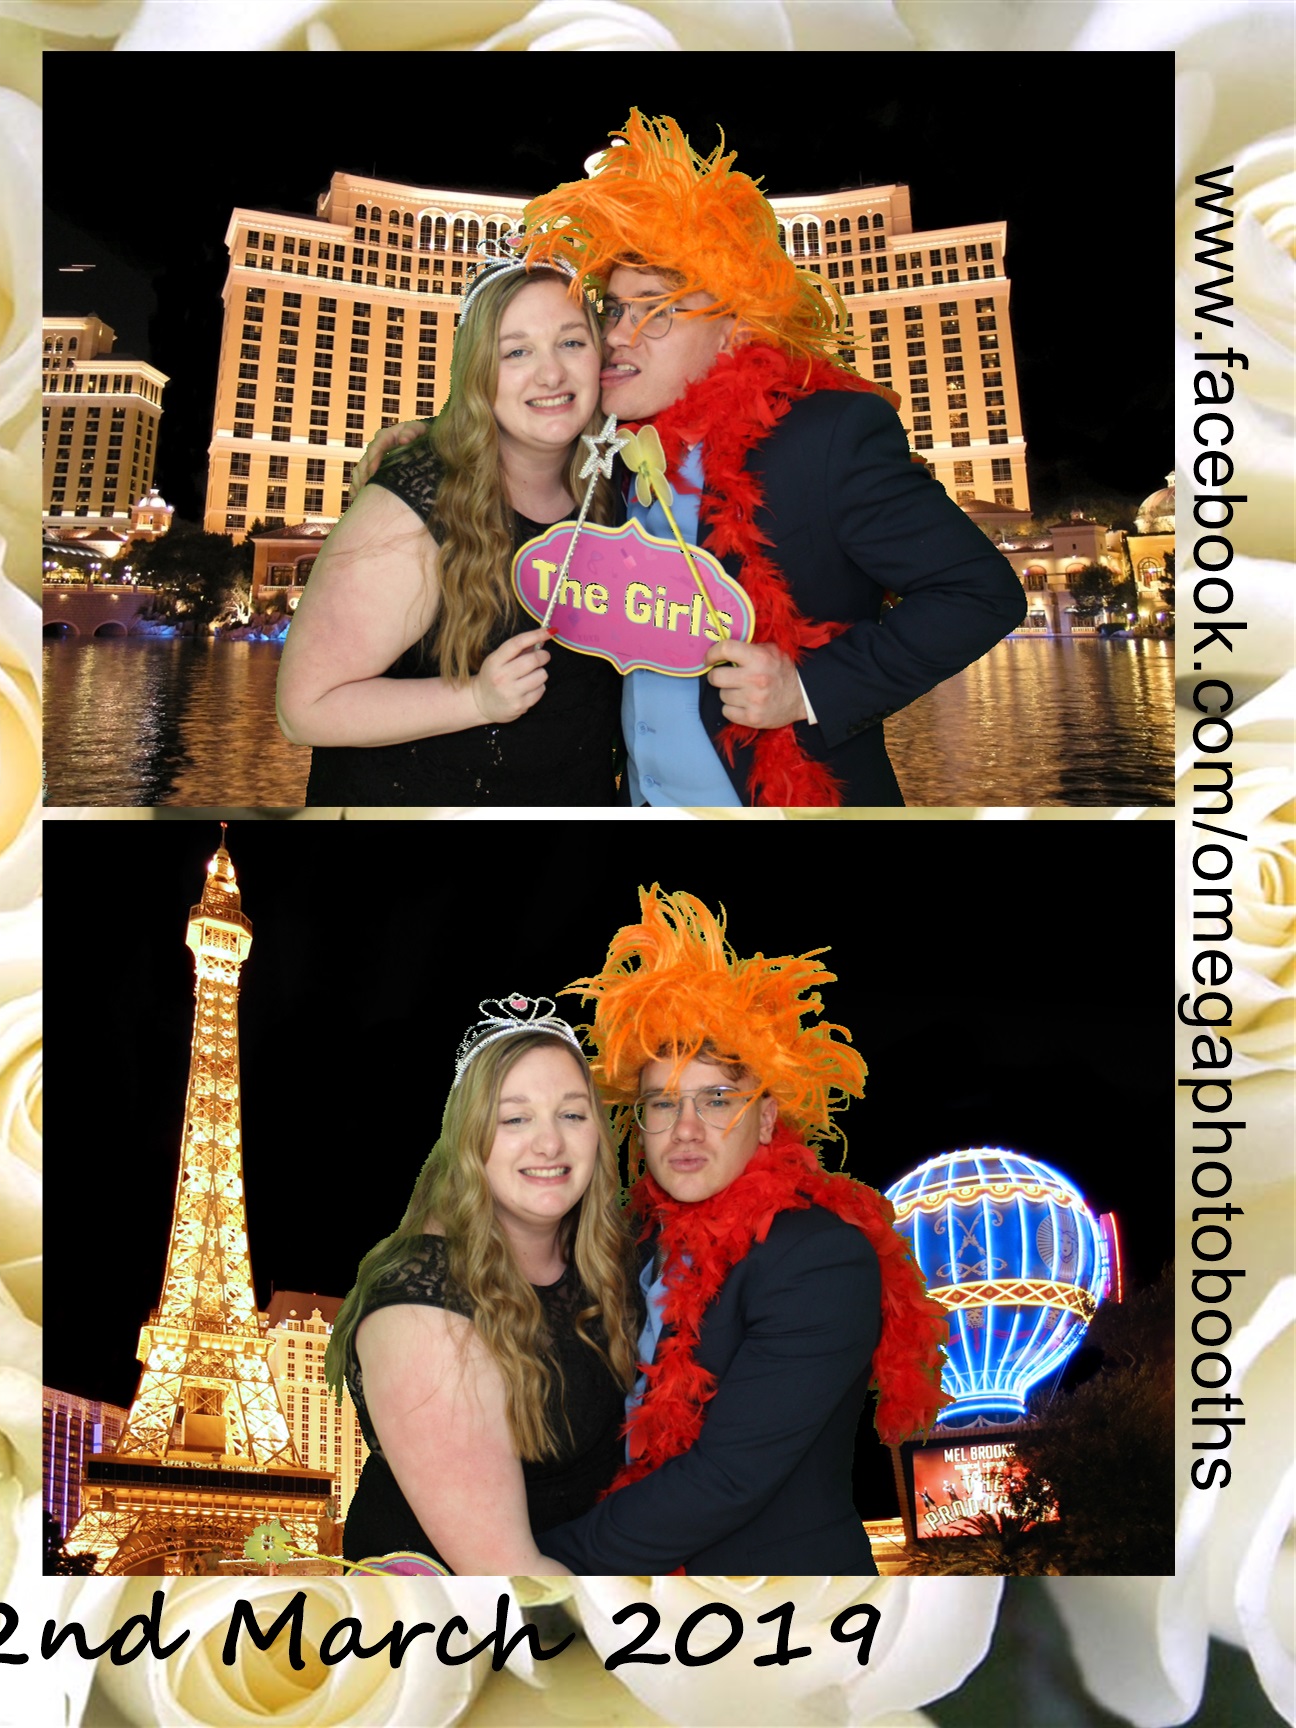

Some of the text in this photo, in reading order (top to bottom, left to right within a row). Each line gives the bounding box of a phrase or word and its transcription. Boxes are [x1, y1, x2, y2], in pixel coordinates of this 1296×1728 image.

[532, 558, 734, 642] The Girls
[944, 1447, 968, 1462] MEL
[161, 1459, 268, 1473] EIFFEL TOWER RESTAURANT
